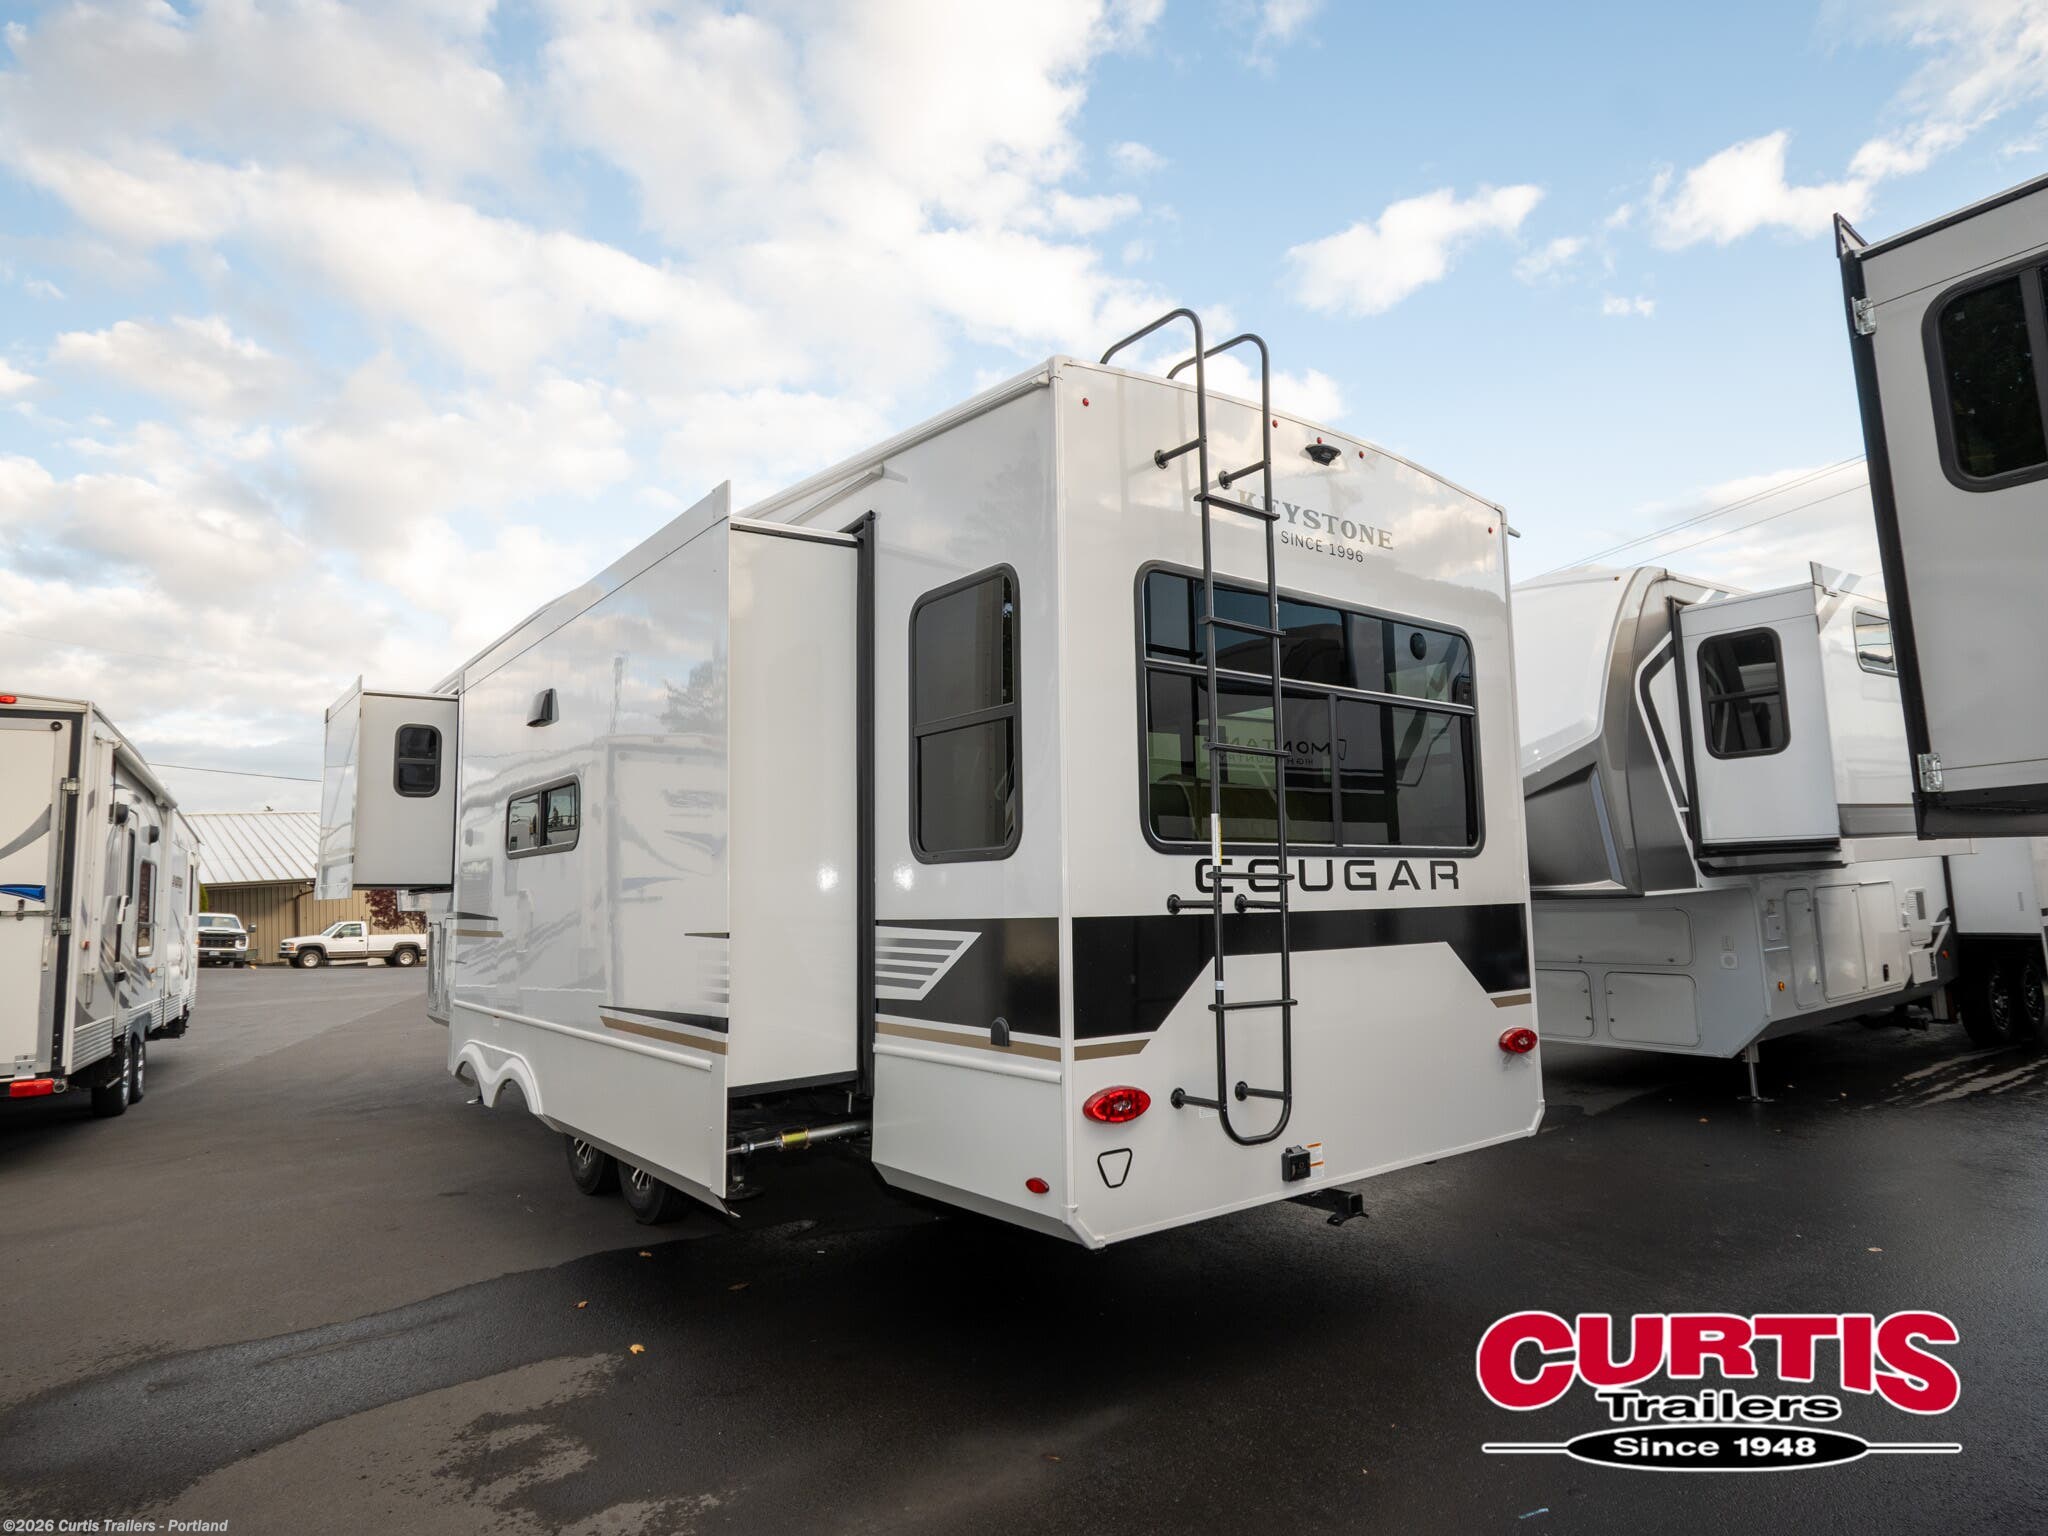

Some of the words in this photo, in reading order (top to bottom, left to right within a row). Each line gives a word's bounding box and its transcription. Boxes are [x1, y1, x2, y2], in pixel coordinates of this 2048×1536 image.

[1281, 530, 1323, 553] SINCE
[1329, 543, 1364, 563] 1996
[1195, 858, 1459, 894] COUGAR
